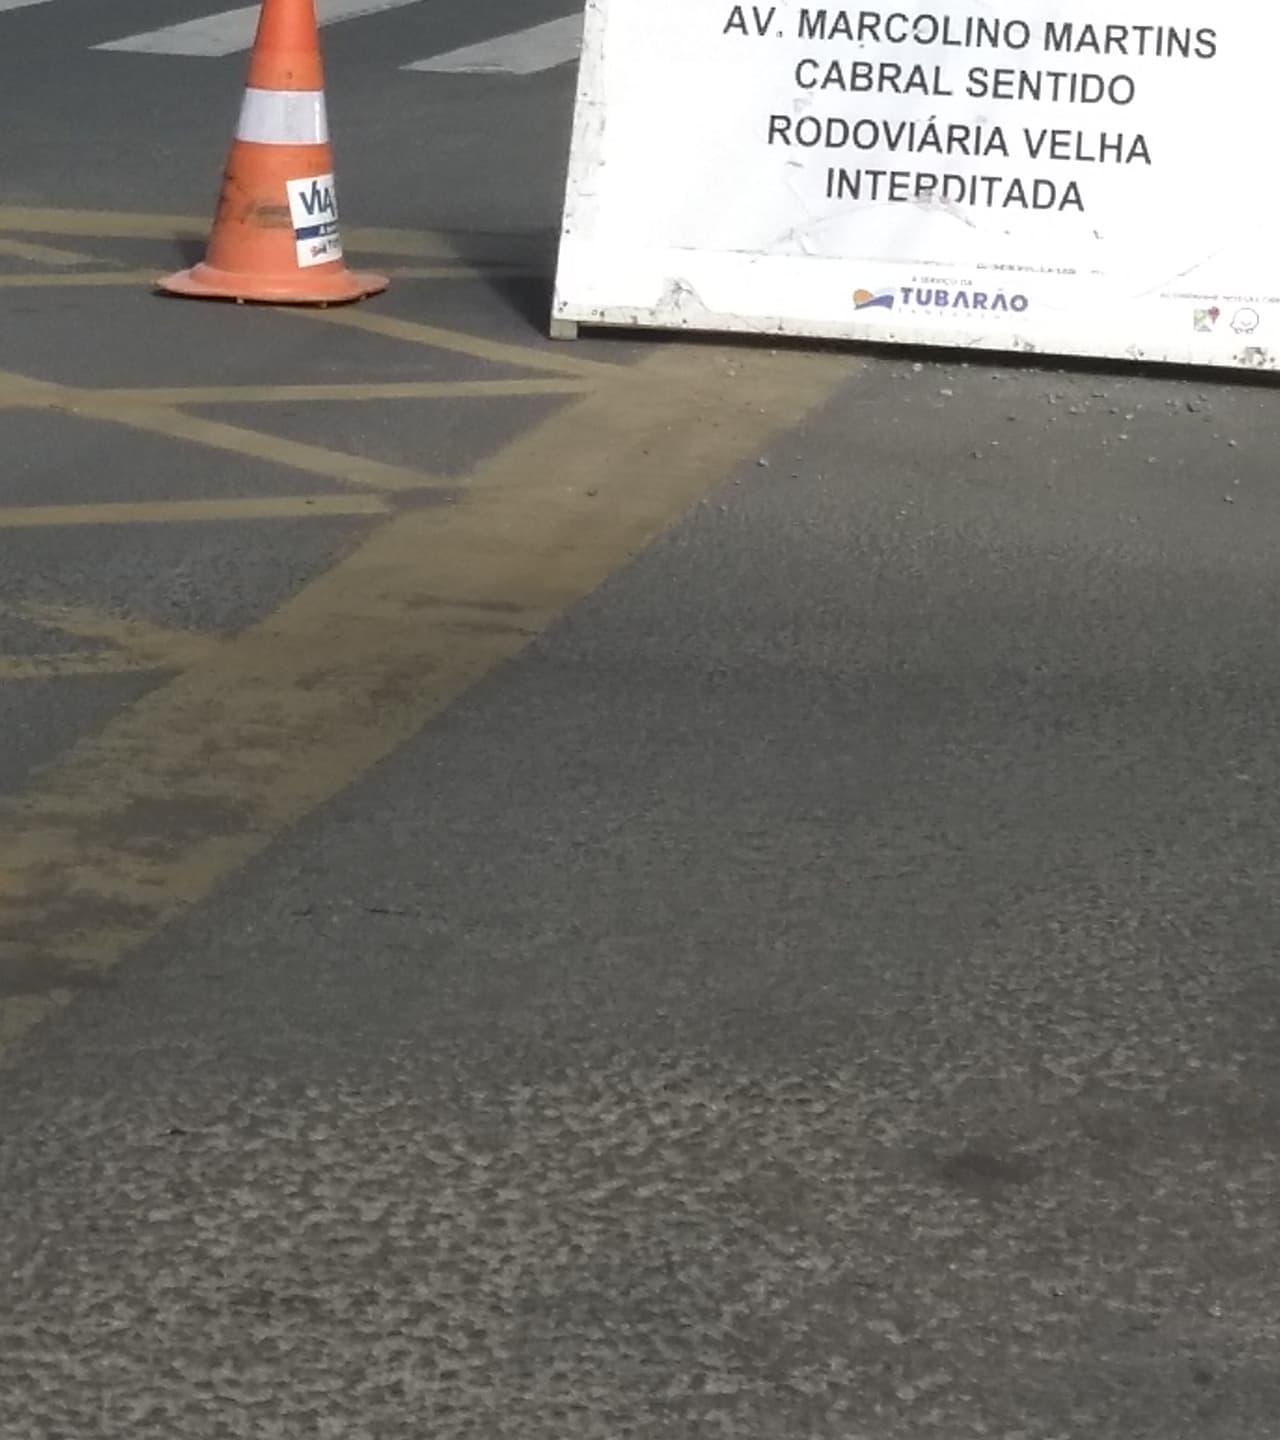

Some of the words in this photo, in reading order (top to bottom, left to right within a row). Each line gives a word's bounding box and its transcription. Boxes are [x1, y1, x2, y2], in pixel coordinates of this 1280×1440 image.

[723, 5, 784, 37] AV.
[798, 8, 1031, 50] MARCOLINO
[1044, 21, 1218, 59] MARTINS
[794, 58, 953, 96] CABRAL
[965, 66, 1136, 105] SENTIDO
[767, 114, 1009, 157] RODOVIÁRIA
[1023, 128, 1152, 165] VELHA
[826, 167, 1085, 212] INTERDITADA
[900, 286, 1029, 312] TUBARÃO
